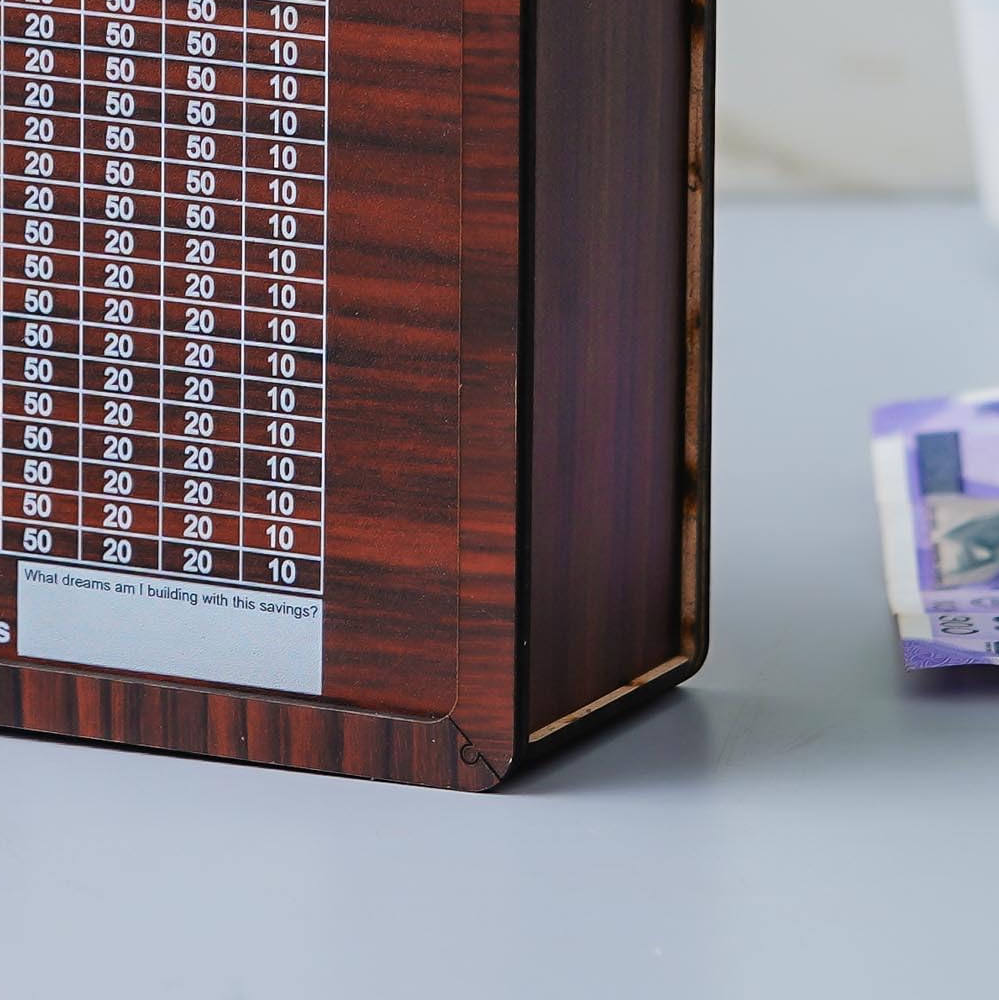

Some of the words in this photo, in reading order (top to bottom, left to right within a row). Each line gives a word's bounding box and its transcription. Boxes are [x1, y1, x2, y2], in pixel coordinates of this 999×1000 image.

[270, 4, 299, 31] 10
[24, 47, 55, 74] 20
[105, 56, 135, 83] 50
[186, 65, 216, 92] 50
[269, 73, 298, 101] 10
[24, 116, 54, 143] 20
[105, 125, 135, 152] 50
[186, 134, 216, 161] 50
[269, 143, 297, 170] 10
[24, 185, 54, 212] 20
[104, 194, 135, 221] 50
[186, 203, 216, 230] 50
[268, 213, 297, 240] 10
[24, 253, 54, 280] 50
[104, 263, 134, 290] 20
[184, 272, 215, 300] 20
[267, 282, 296, 309] 10
[23, 356, 53, 383] 50
[103, 366, 134, 393] 20
[184, 376, 214, 403] 20
[267, 386, 296, 413] 10
[23, 458, 53, 485] 50
[103, 469, 133, 496] 20
[183, 479, 213, 506] 20
[266, 489, 294, 516] 10
[22, 527, 52, 554] 50
[102, 537, 132, 564] 20
[182, 547, 213, 574] 20
[268, 557, 296, 584] 10
[24, 568, 58, 585] What
[62, 574, 111, 592] dreams
[114, 583, 135, 595] am
[147, 584, 198, 606] building
[202, 591, 228, 608] with
[232, 595, 256, 611] this
[259, 600, 318, 619] savings?
